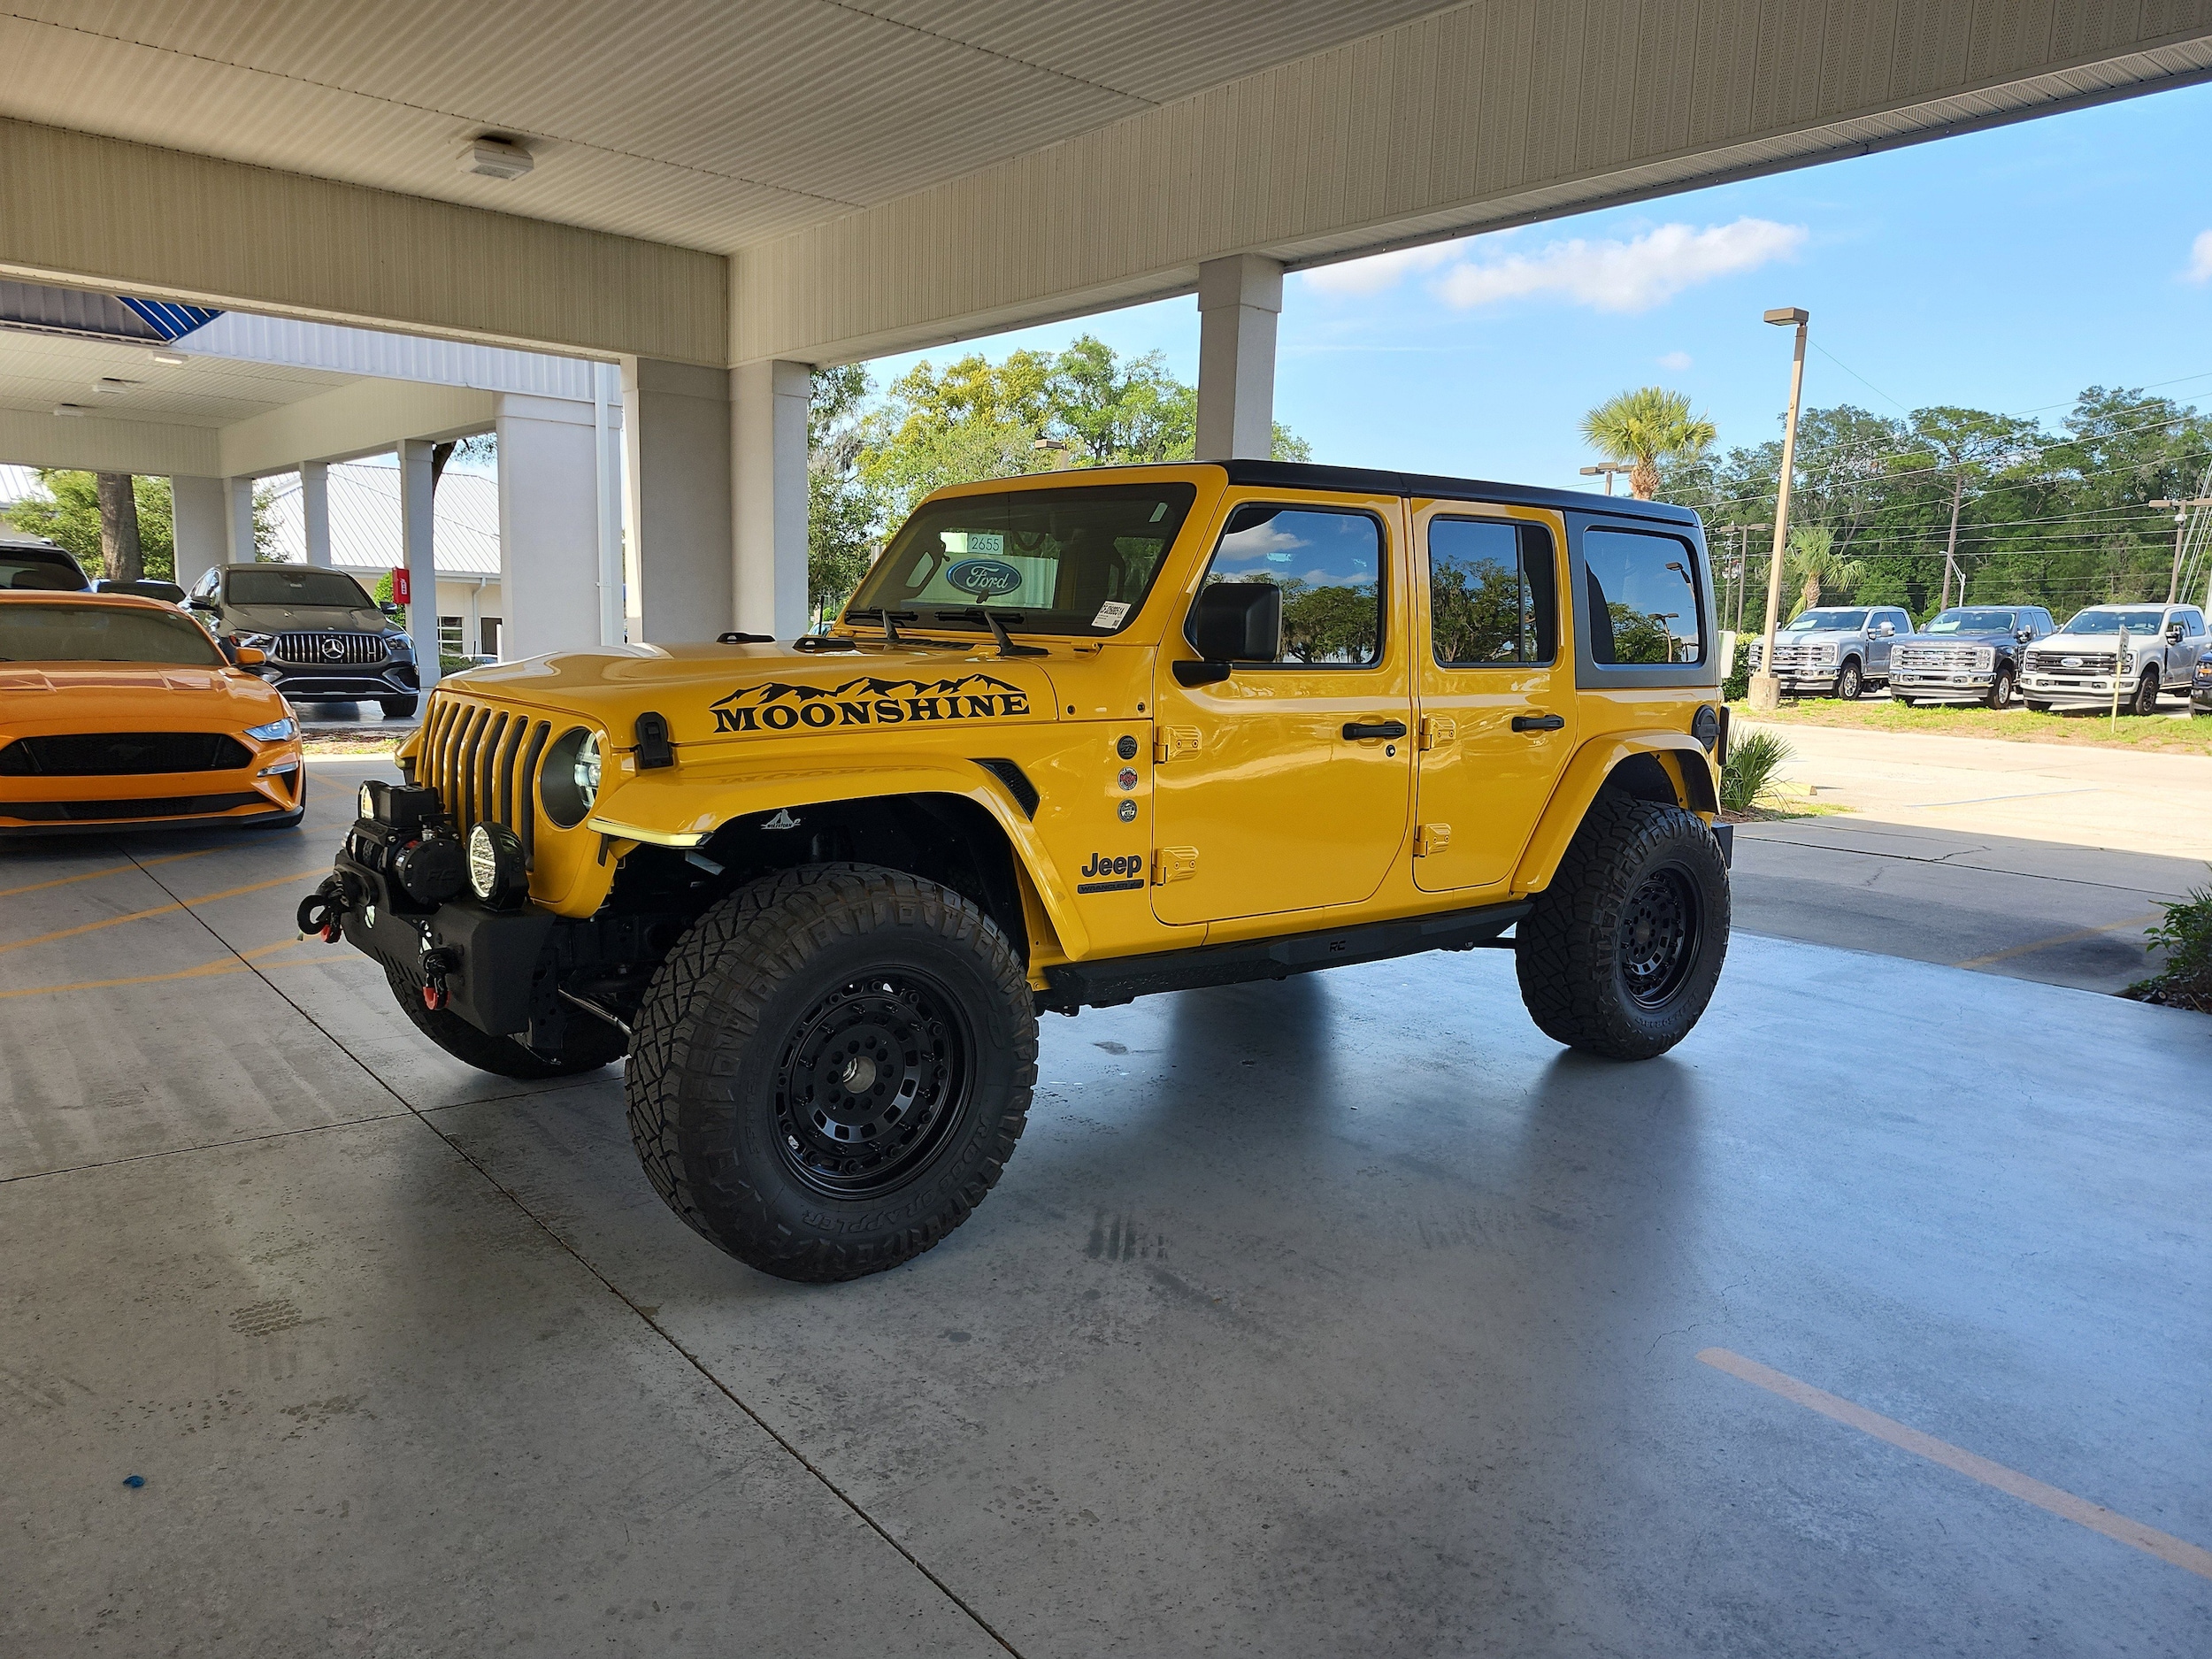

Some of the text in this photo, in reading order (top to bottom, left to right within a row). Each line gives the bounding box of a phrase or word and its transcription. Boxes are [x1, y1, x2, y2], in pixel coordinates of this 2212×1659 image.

[972, 537, 1000, 551] 2655
[965, 565, 1010, 589] Ford
[709, 693, 1030, 733] MOONSHINE
[1081, 852, 1142, 878] Jeep
[1080, 883, 1129, 893] WRANGLER
[1329, 940, 1347, 953] RC
[801, 1189, 936, 1234] GRAPPLER
